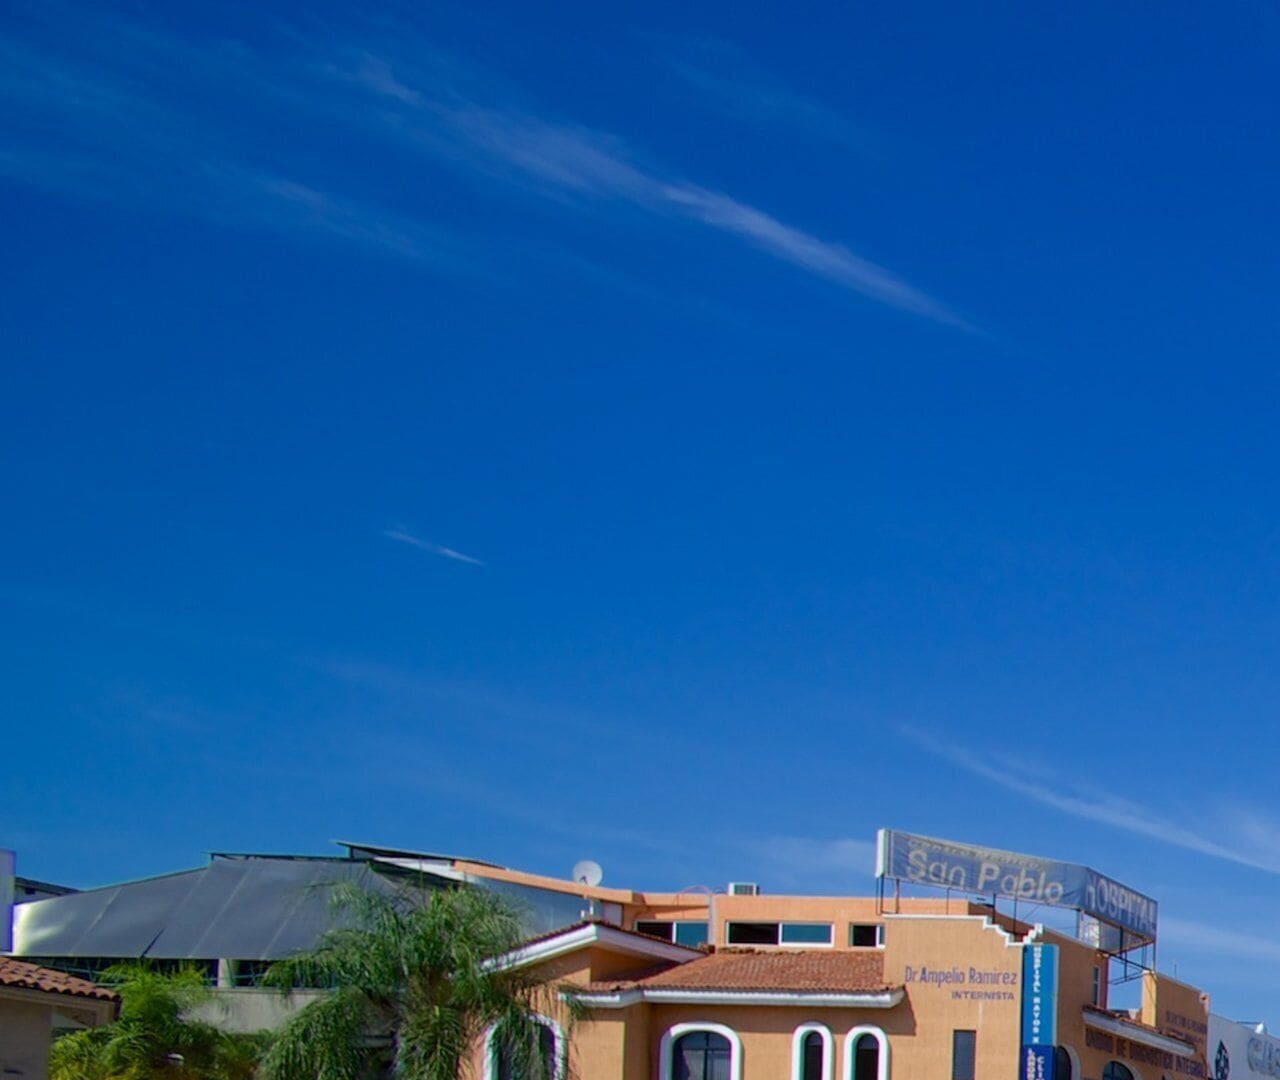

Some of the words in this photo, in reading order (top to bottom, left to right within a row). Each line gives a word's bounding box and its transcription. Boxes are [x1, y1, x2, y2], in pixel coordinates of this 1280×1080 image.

[907, 849, 966, 890] San
[978, 861, 1064, 904] Pablo
[919, 967, 965, 987] Ampelio
[951, 990, 1015, 1000] INTERNISTA
